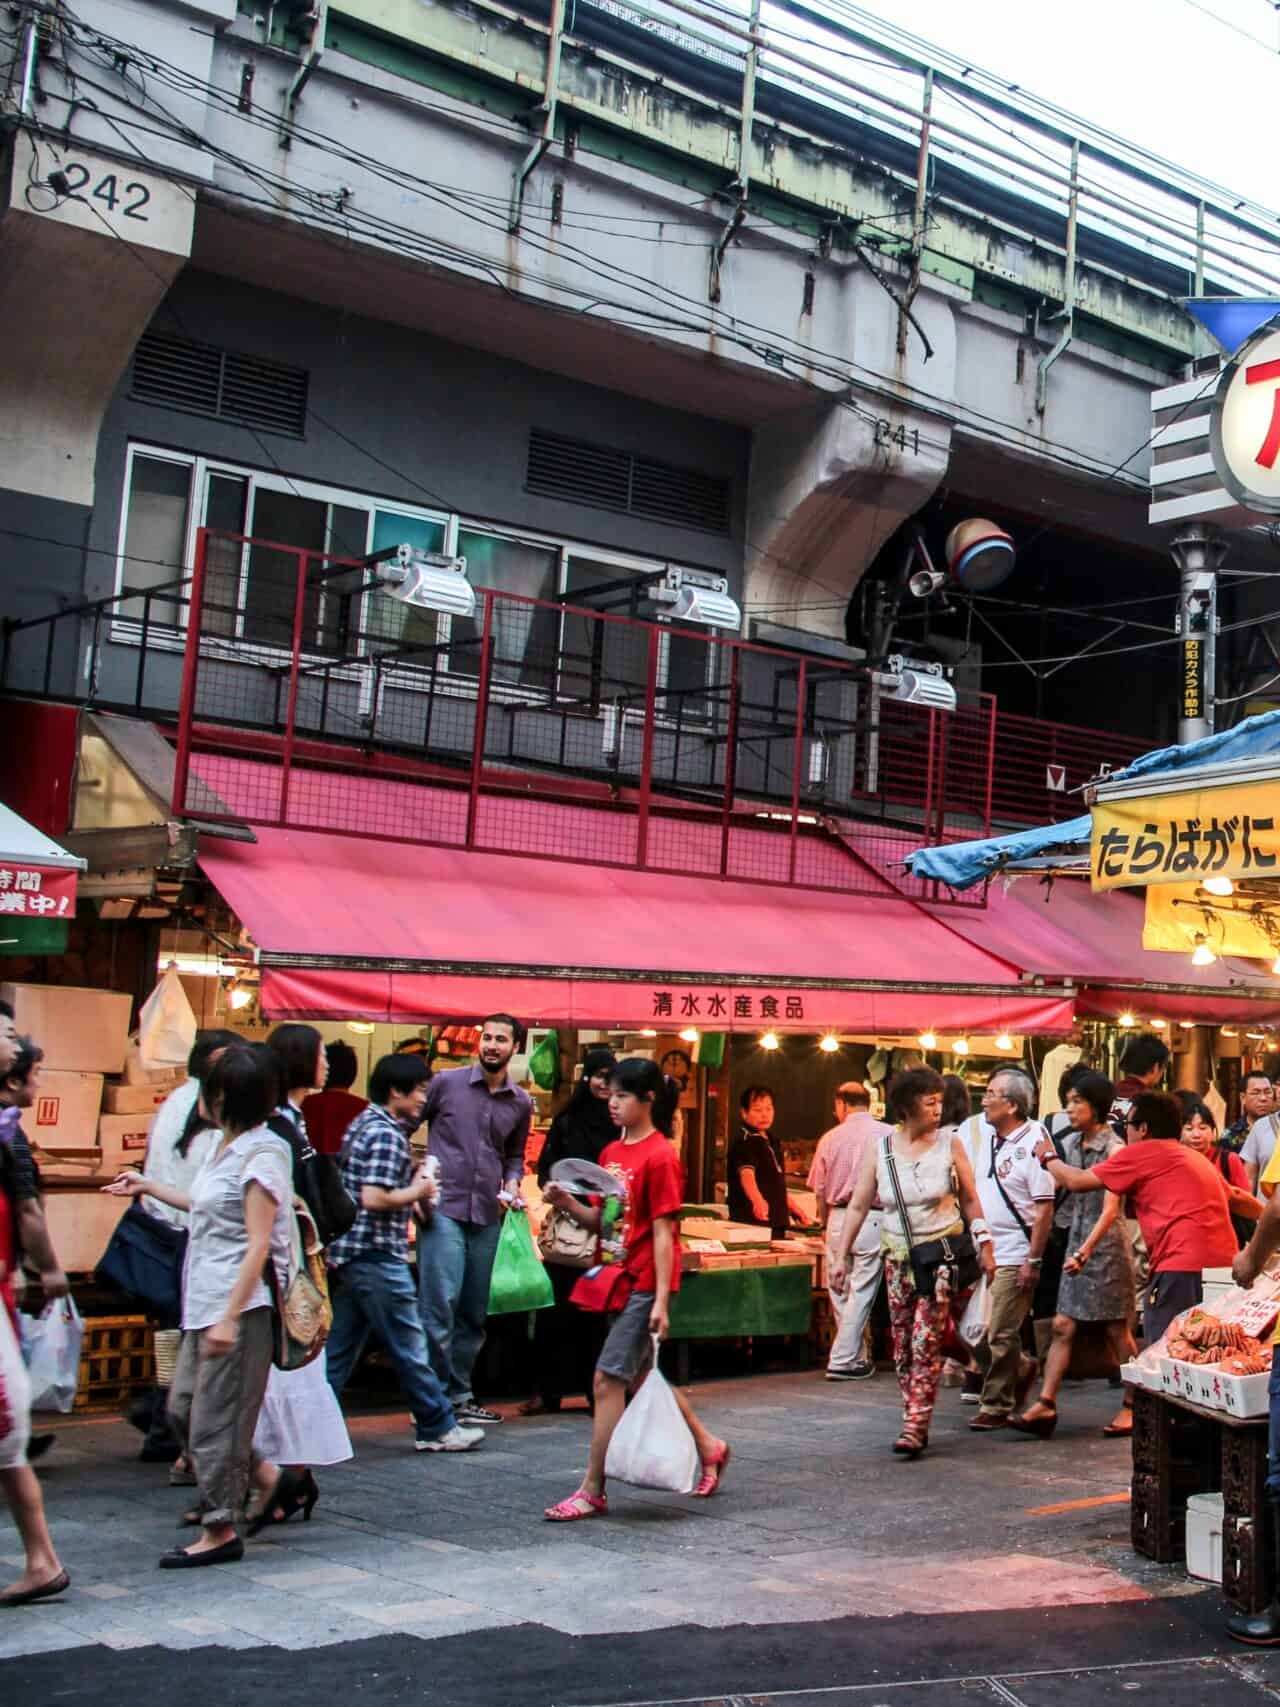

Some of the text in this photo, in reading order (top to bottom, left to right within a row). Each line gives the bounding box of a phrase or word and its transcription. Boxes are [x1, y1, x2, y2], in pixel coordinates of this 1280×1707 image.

[64, 162, 151, 222] 242
[1097, 814, 1276, 879] たらばがに
[653, 991, 804, 1019] 清水水産食品
